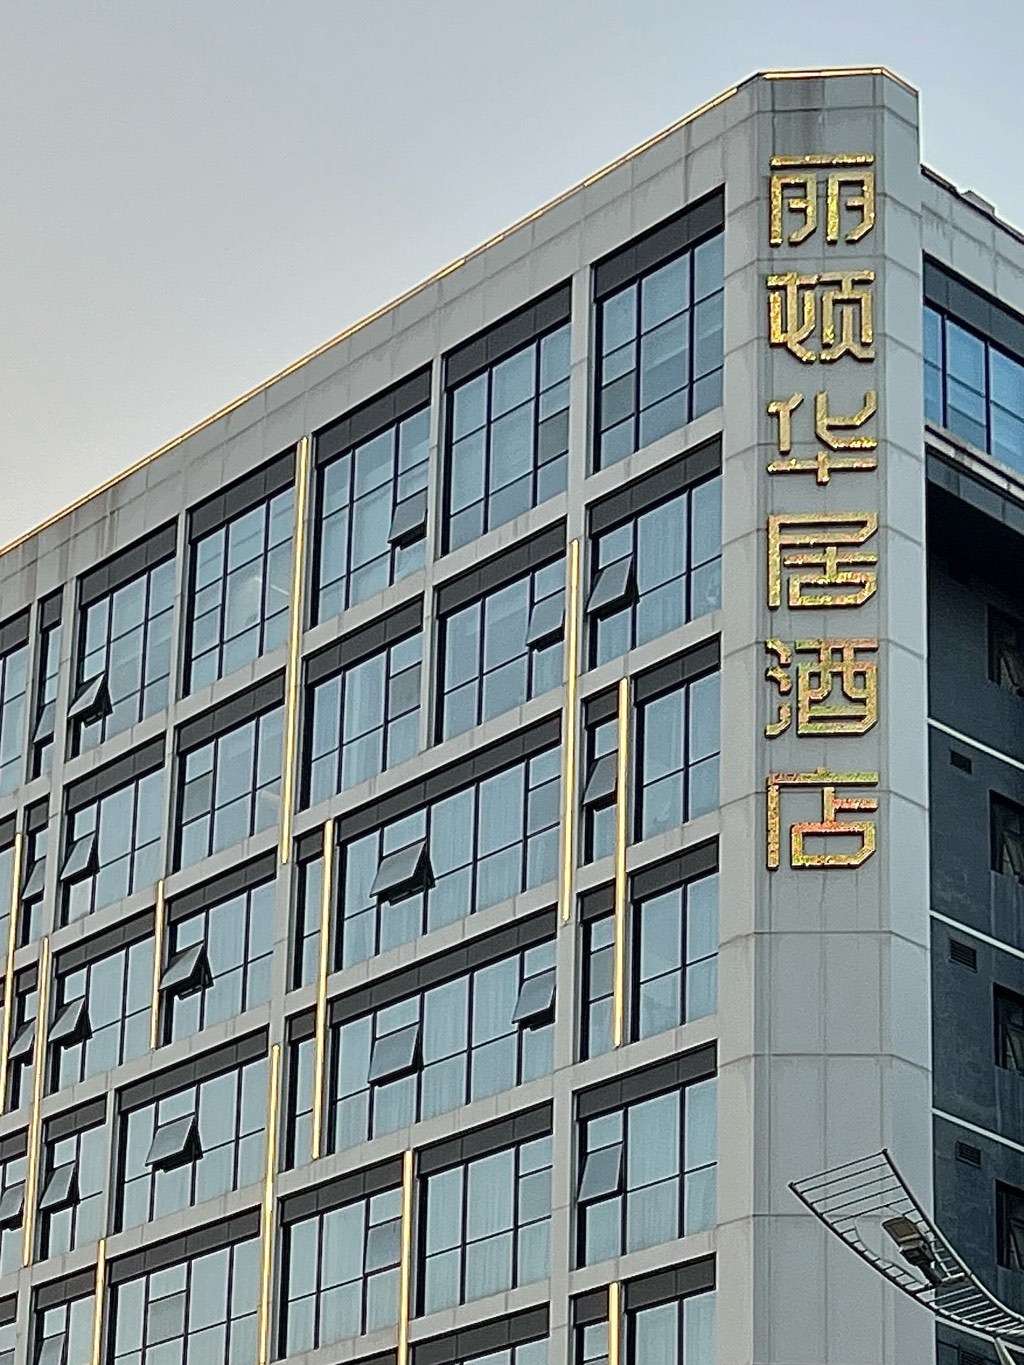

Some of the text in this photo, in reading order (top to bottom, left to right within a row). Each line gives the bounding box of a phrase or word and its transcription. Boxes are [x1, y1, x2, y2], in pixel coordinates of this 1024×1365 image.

[765, 153, 880, 871] 丽顿华居酒店
